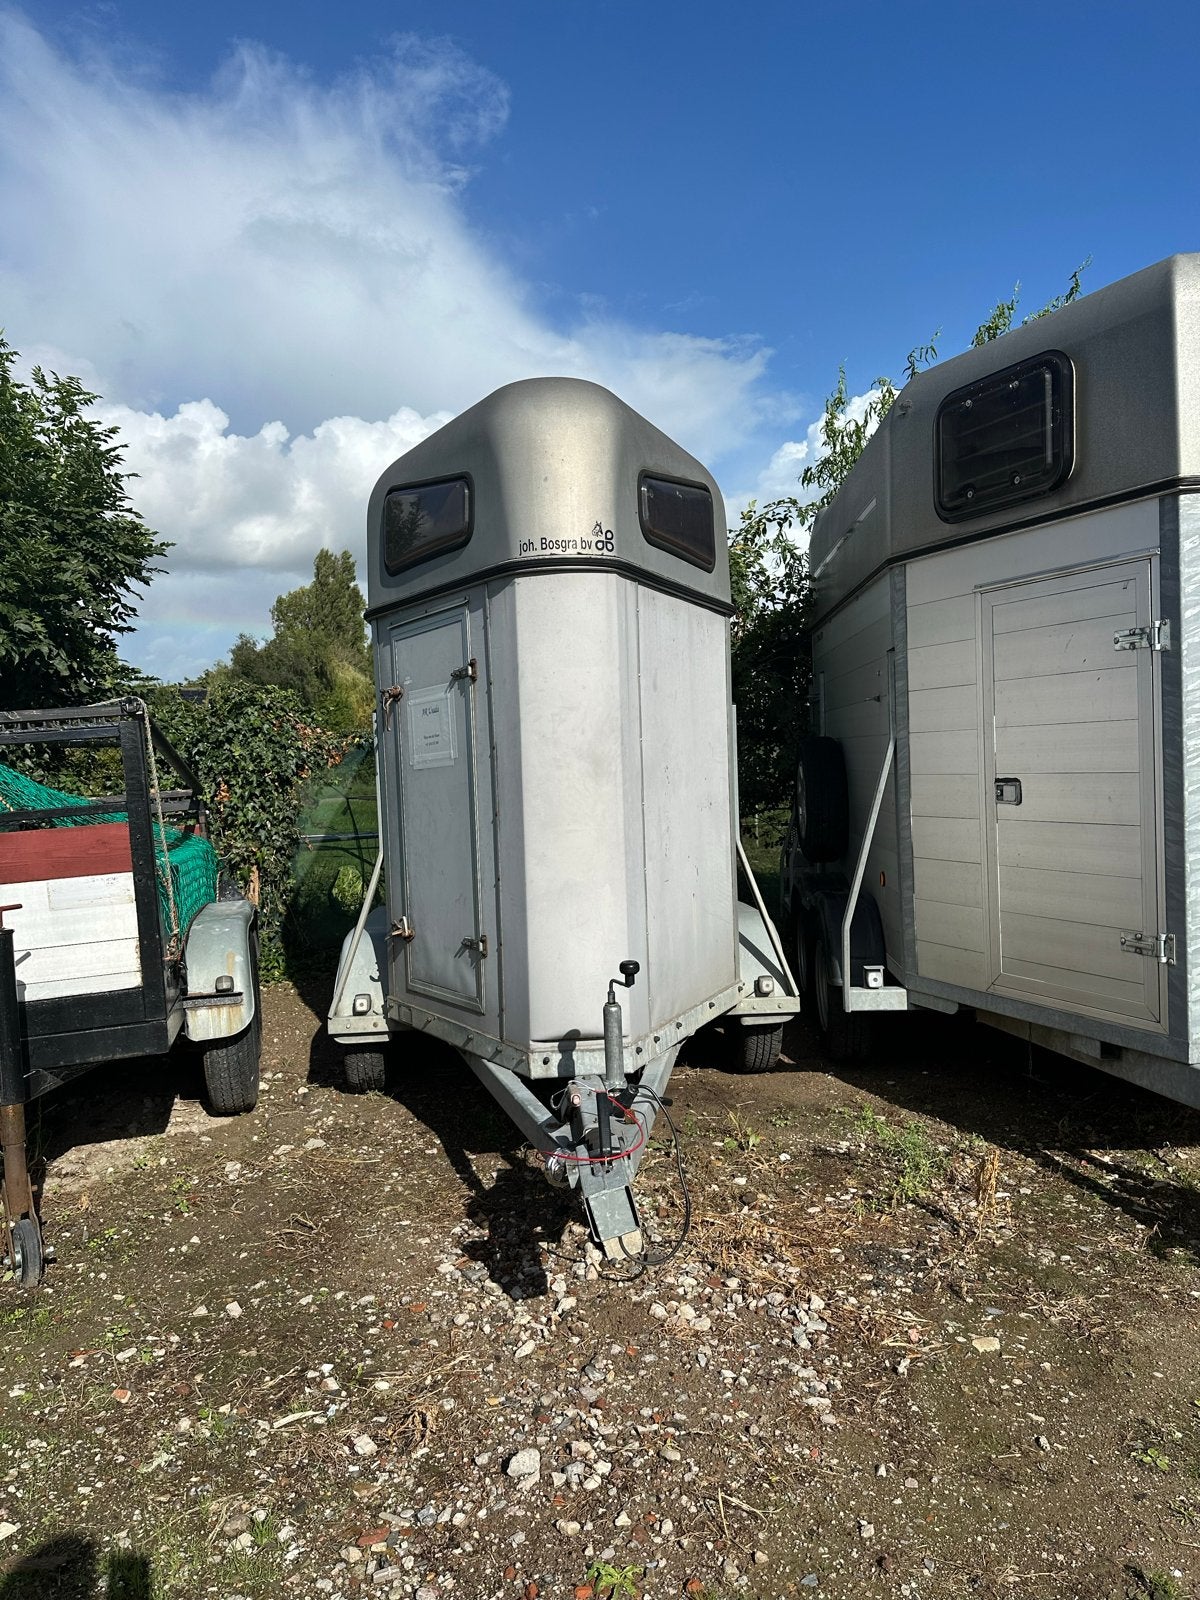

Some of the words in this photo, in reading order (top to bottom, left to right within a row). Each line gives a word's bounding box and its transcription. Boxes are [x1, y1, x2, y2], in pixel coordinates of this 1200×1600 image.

[519, 539, 537, 556] joh.
[540, 537, 578, 552] Bosgra
[580, 537, 592, 550] bv
